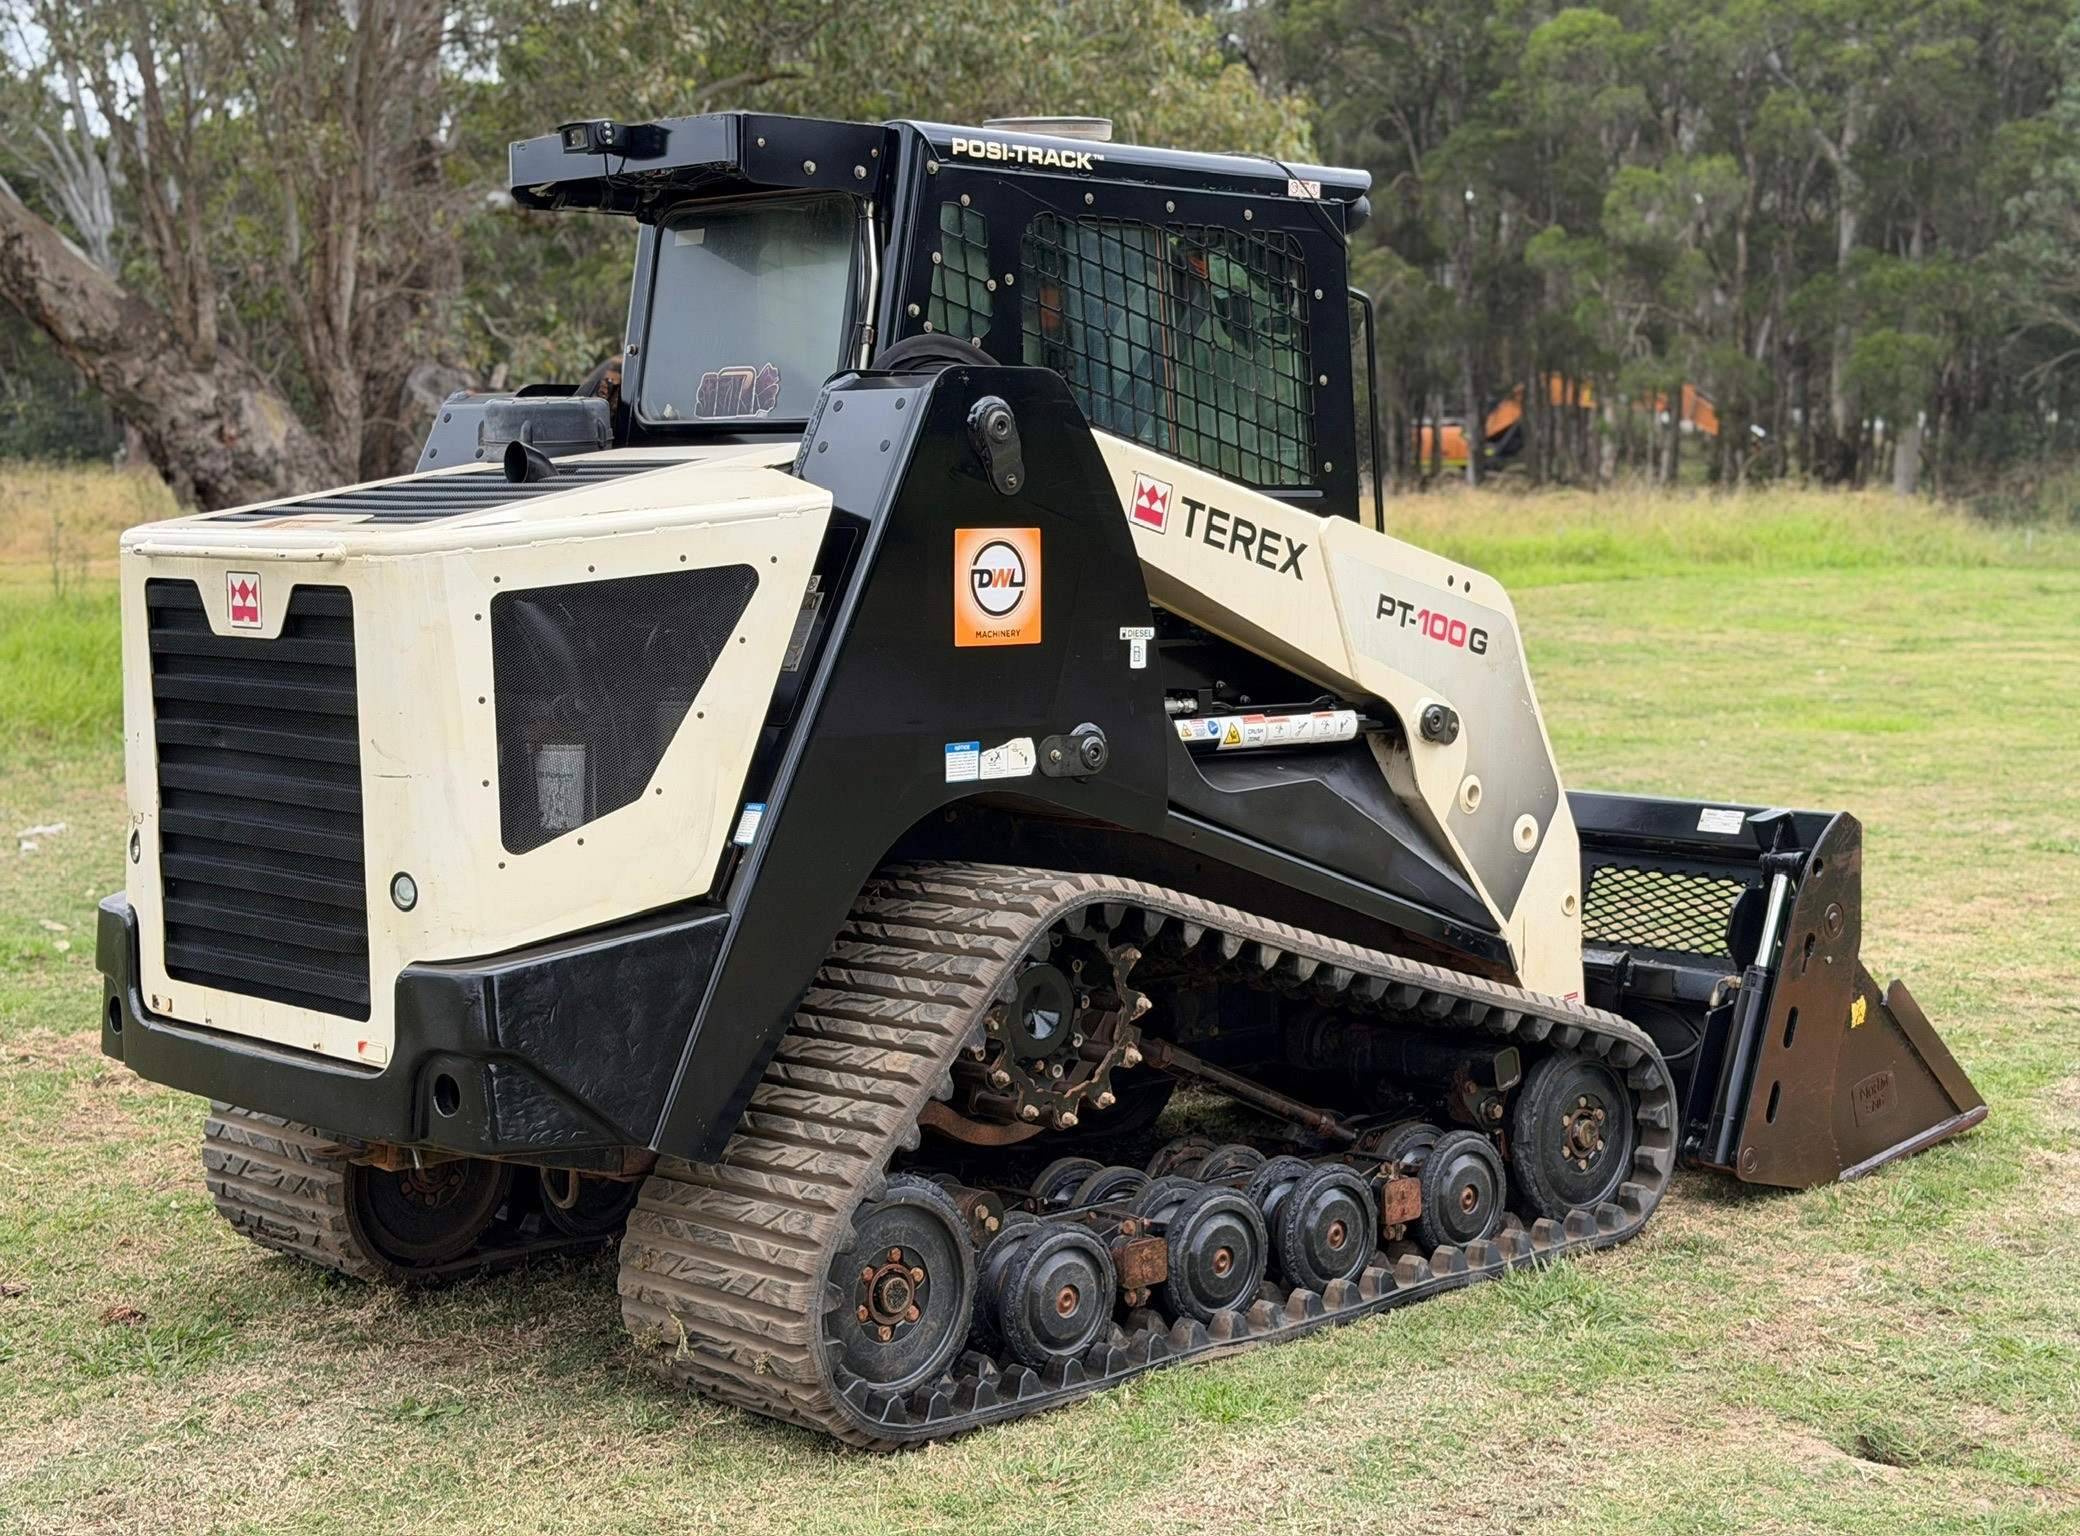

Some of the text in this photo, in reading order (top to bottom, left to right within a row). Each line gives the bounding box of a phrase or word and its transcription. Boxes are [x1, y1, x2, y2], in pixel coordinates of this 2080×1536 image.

[1181, 495, 1309, 581] TEREX
[971, 568, 1025, 588] DWL
[975, 629, 1021, 638] MACHINERY
[1127, 629, 1153, 638] DIESEL
[1376, 593, 1488, 655] PT-100G
